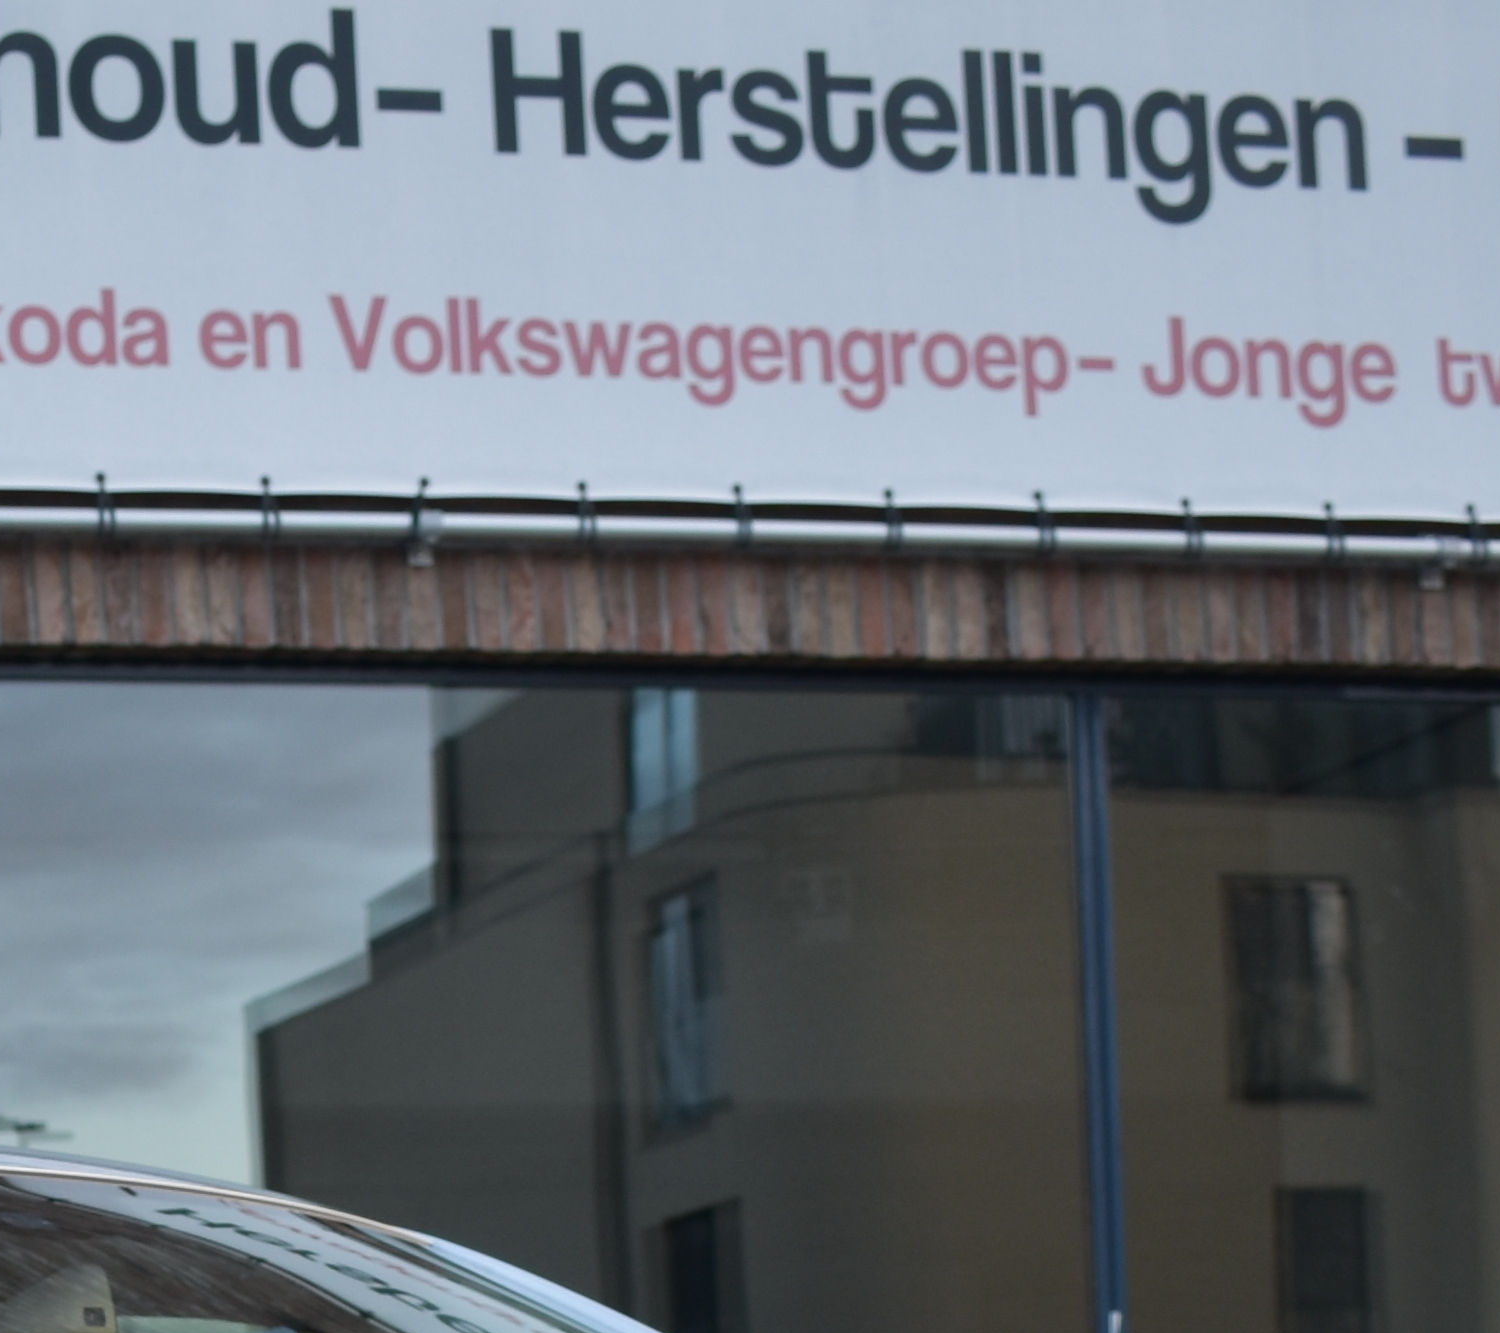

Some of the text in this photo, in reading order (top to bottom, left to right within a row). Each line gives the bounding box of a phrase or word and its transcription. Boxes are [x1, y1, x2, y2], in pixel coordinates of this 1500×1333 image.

[486, 27, 1370, 224] Herstellingen
[197, 308, 302, 372] en
[1141, 315, 1398, 430] Jonge
